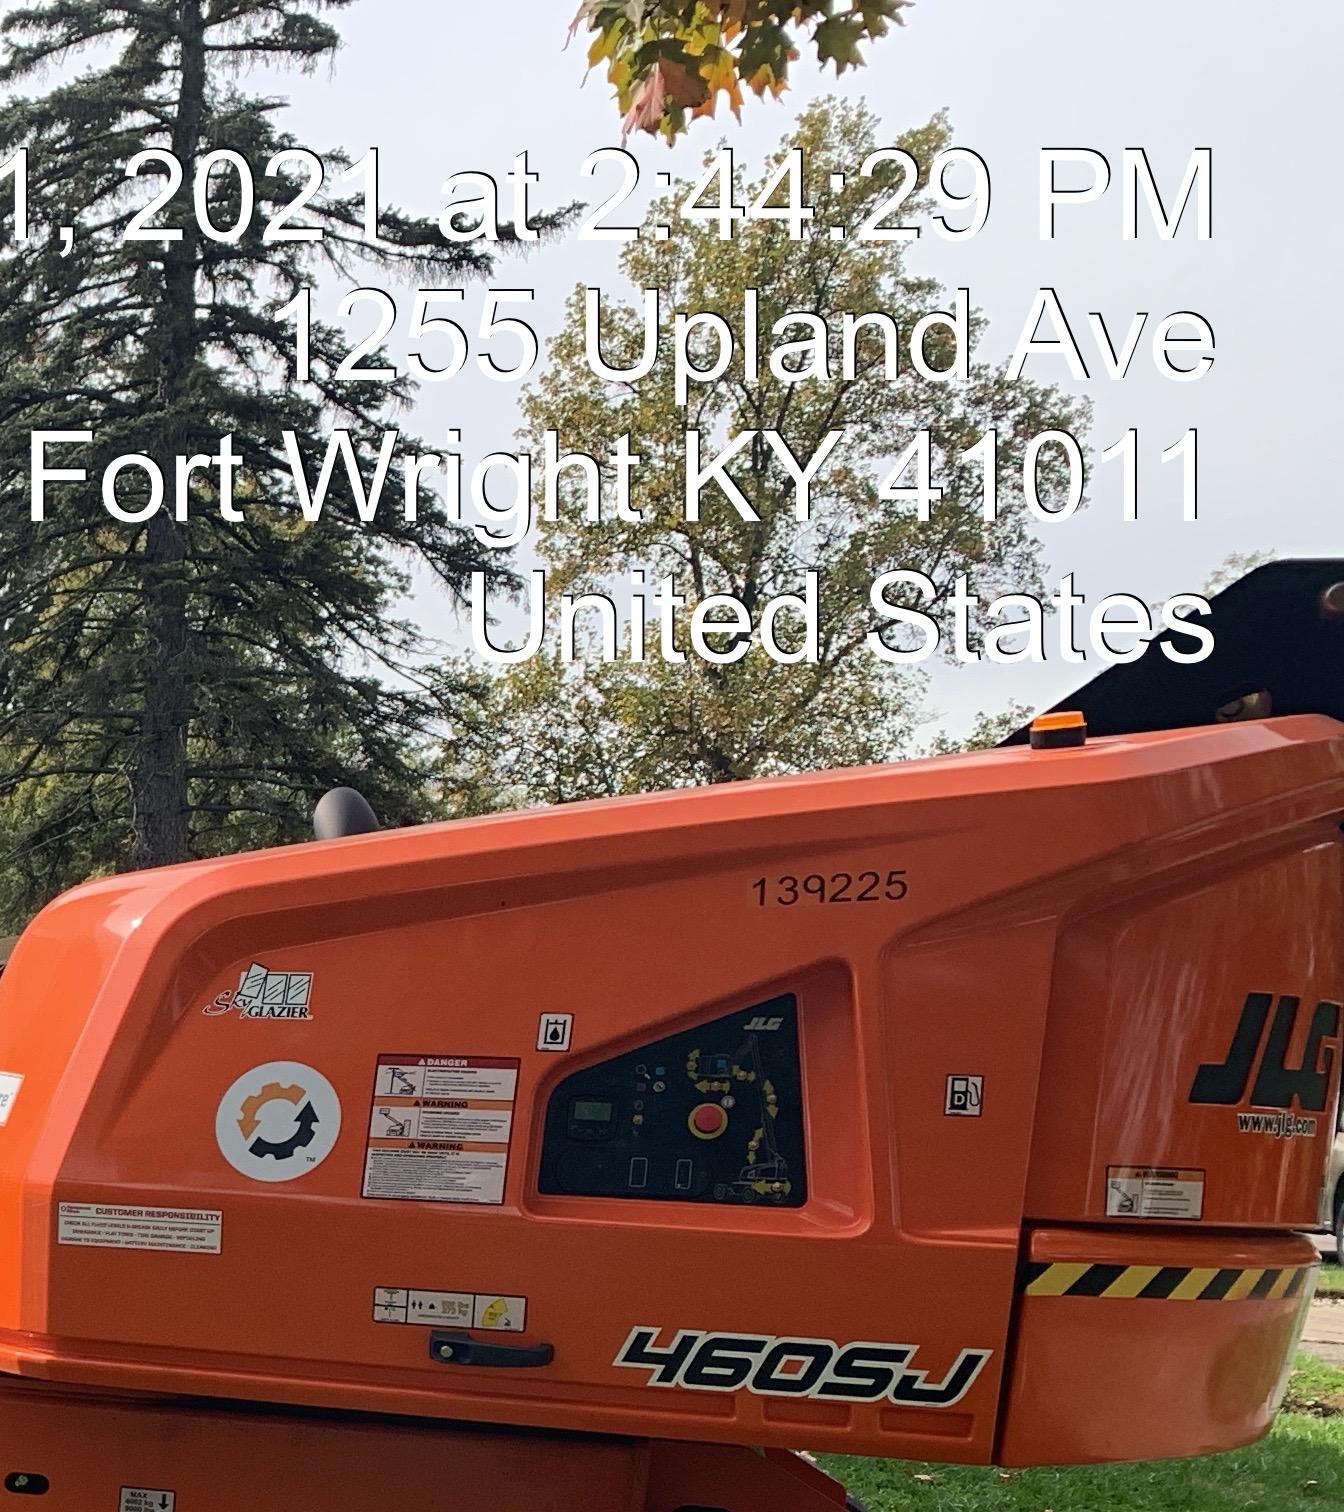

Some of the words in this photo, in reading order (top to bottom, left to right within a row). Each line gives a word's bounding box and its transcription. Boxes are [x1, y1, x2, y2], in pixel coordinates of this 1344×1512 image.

[752, 869, 909, 907] 139225
[203, 990, 253, 1018] Sky
[247, 1005, 309, 1018] GLAZIER
[743, 1016, 784, 1031] JLG
[1188, 991, 1340, 1112] JLG
[426, 1058, 468, 1067] DANGER
[422, 1098, 468, 1108] WARNING
[954, 1093, 966, 1105] D
[1237, 1113, 1317, 1139] www.jlg.com
[416, 1141, 464, 1151] WARNING
[95, 1207, 143, 1217] CUSTOMER
[144, 1210, 220, 1221] RESPONSIBILITY
[613, 1326, 994, 1408] 460SJ
[130, 1491, 148, 1499] MAX
